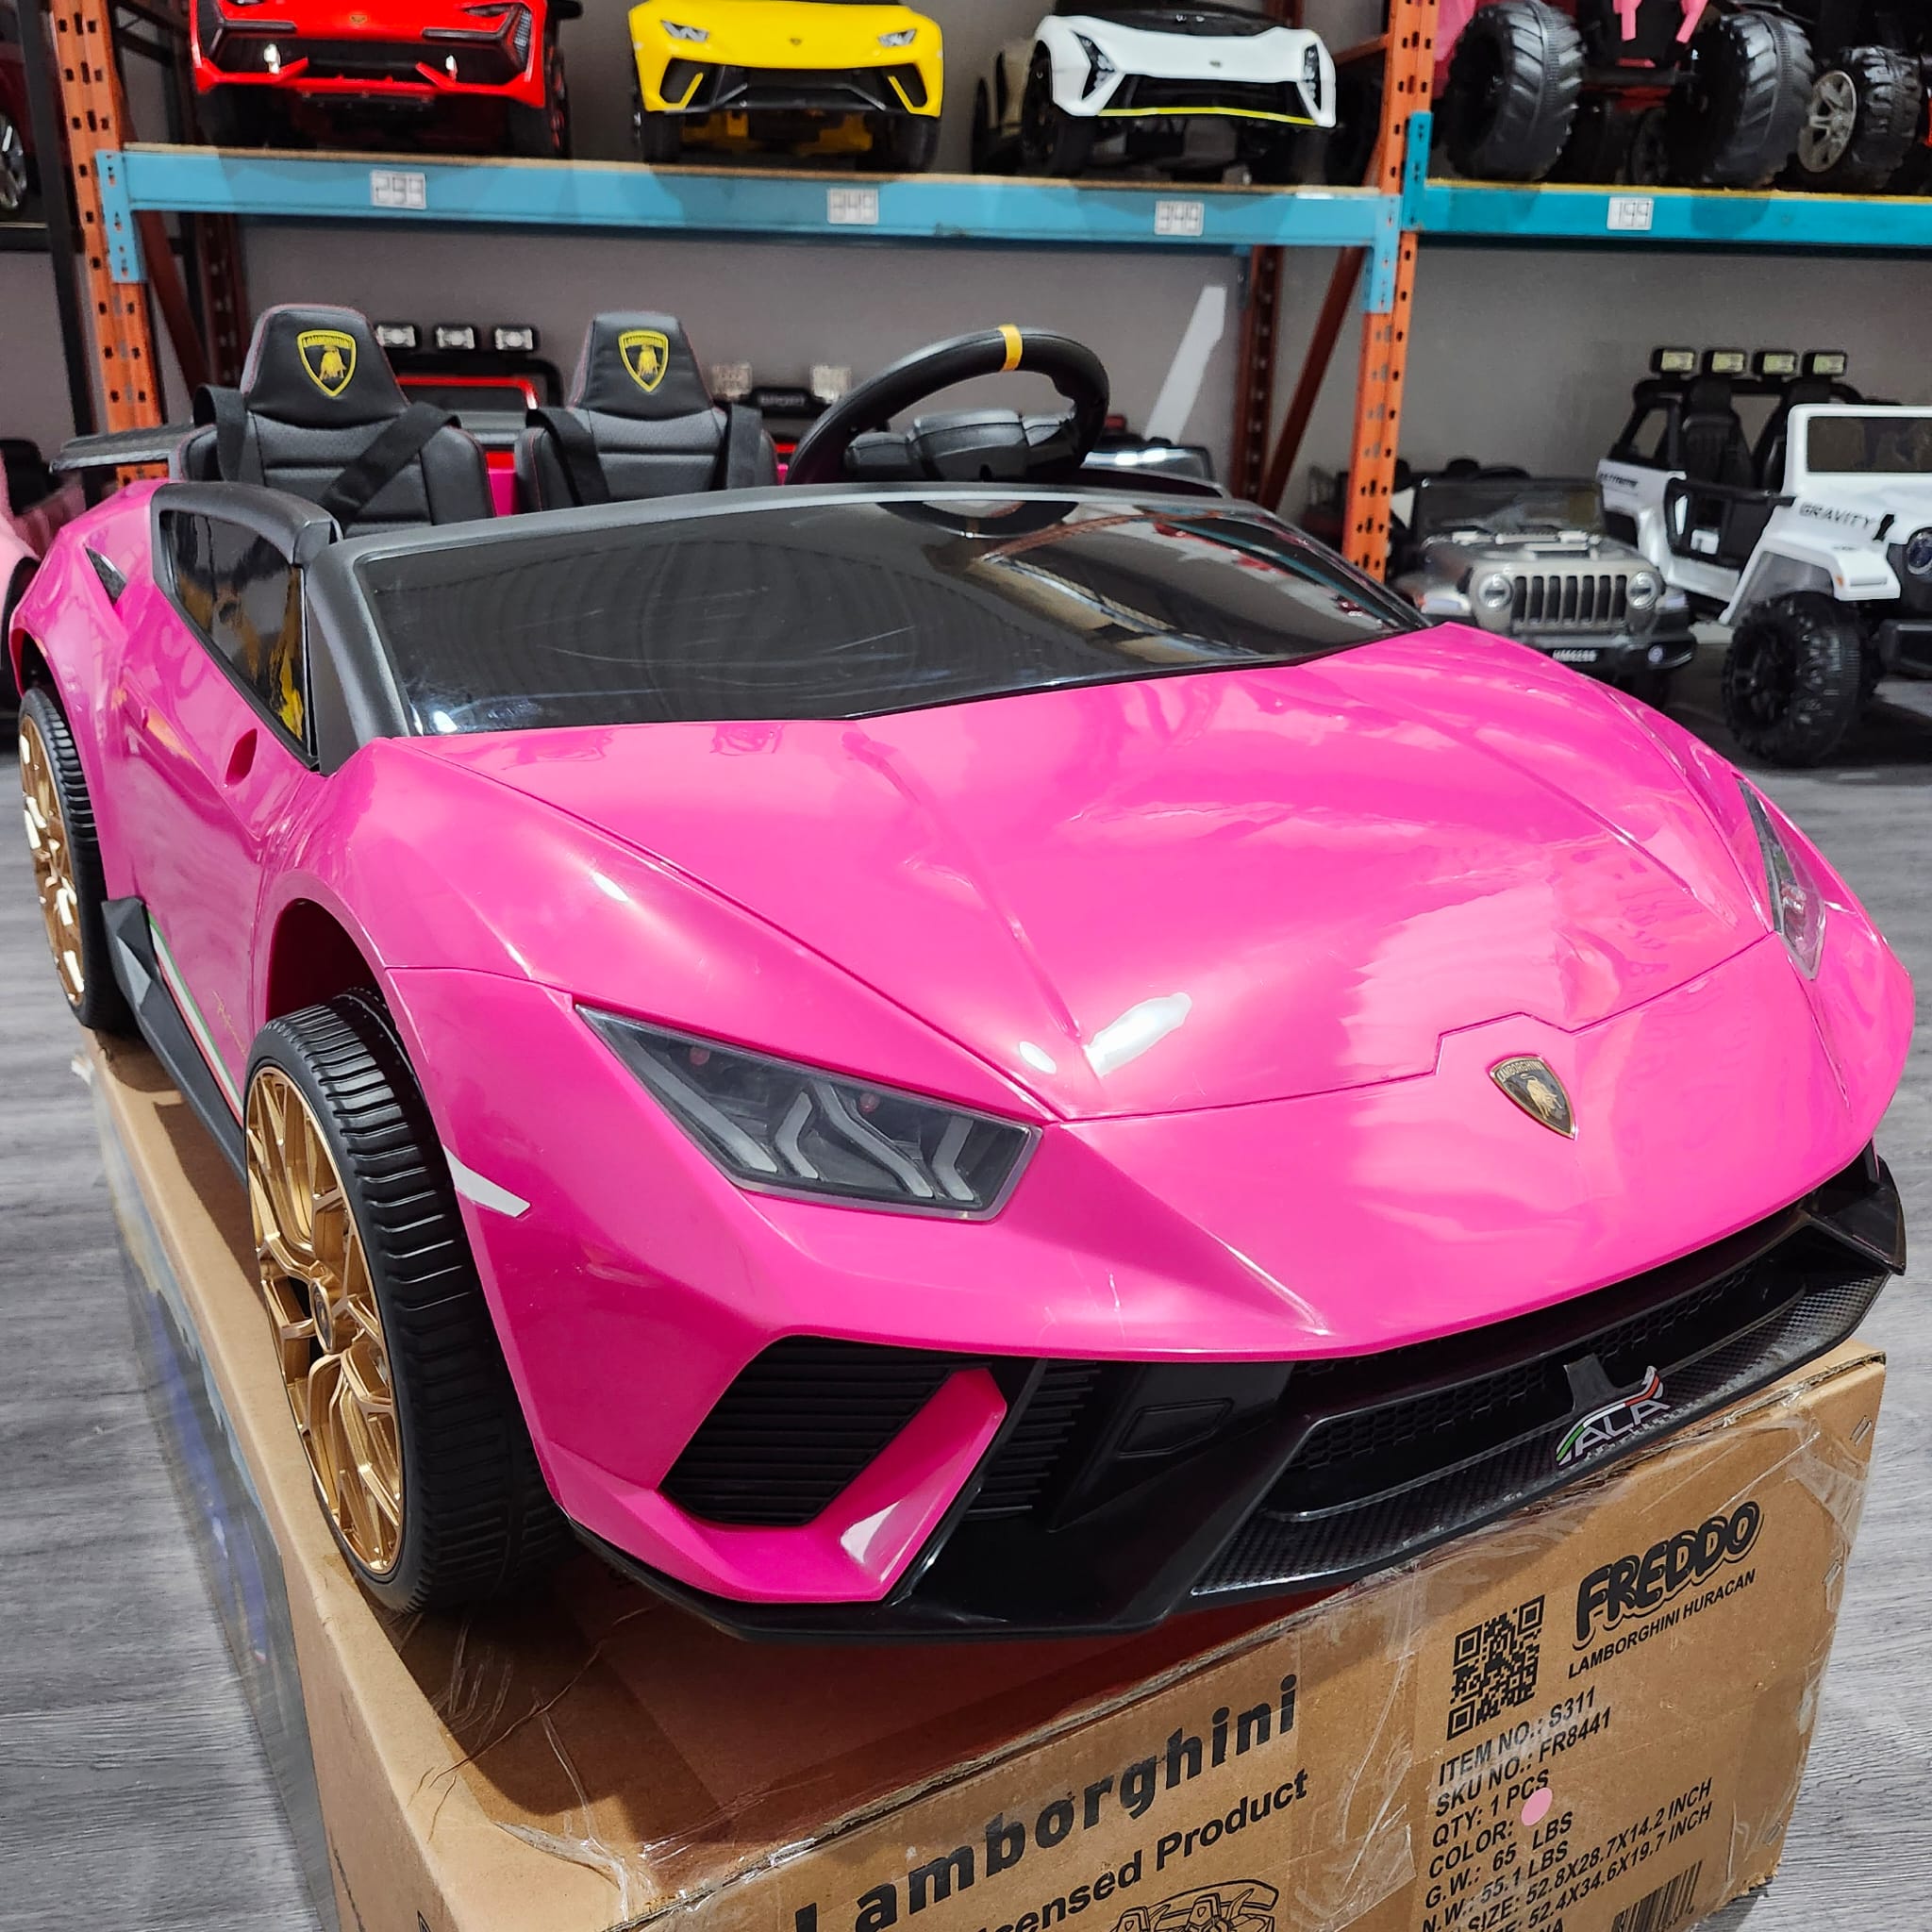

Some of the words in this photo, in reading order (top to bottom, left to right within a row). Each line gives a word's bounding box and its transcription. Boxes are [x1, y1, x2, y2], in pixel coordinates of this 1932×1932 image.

[1574, 1501, 1763, 1647] FREDDO
[1569, 1607, 1680, 1679] LAMBORGHINI
[1683, 1568, 1756, 1620] HURACAN
[1436, 1774, 1482, 1817] SKU
[1489, 1753, 1533, 1790] NO.:
[1539, 1707, 1611, 1763] FR8441
[1439, 1740, 1492, 1787] ITEM
[1549, 1685, 1595, 1727] S311
[1156, 1768, 1308, 1871] Product
[1432, 1806, 1483, 1848] QTY:
[1491, 1794, 1500, 1818] 1
[1506, 1769, 1549, 1809] PCS
[1668, 1776, 1712, 1821] INCH
[1669, 1801, 1713, 1844] INCH
[1425, 1866, 1481, 1908] G.W.:
[1492, 1841, 1517, 1872] 65
[1532, 1810, 1573, 1850] LBS
[1429, 1820, 1514, 1879] COLOR:
[1527, 1840, 1568, 1879] LBS
